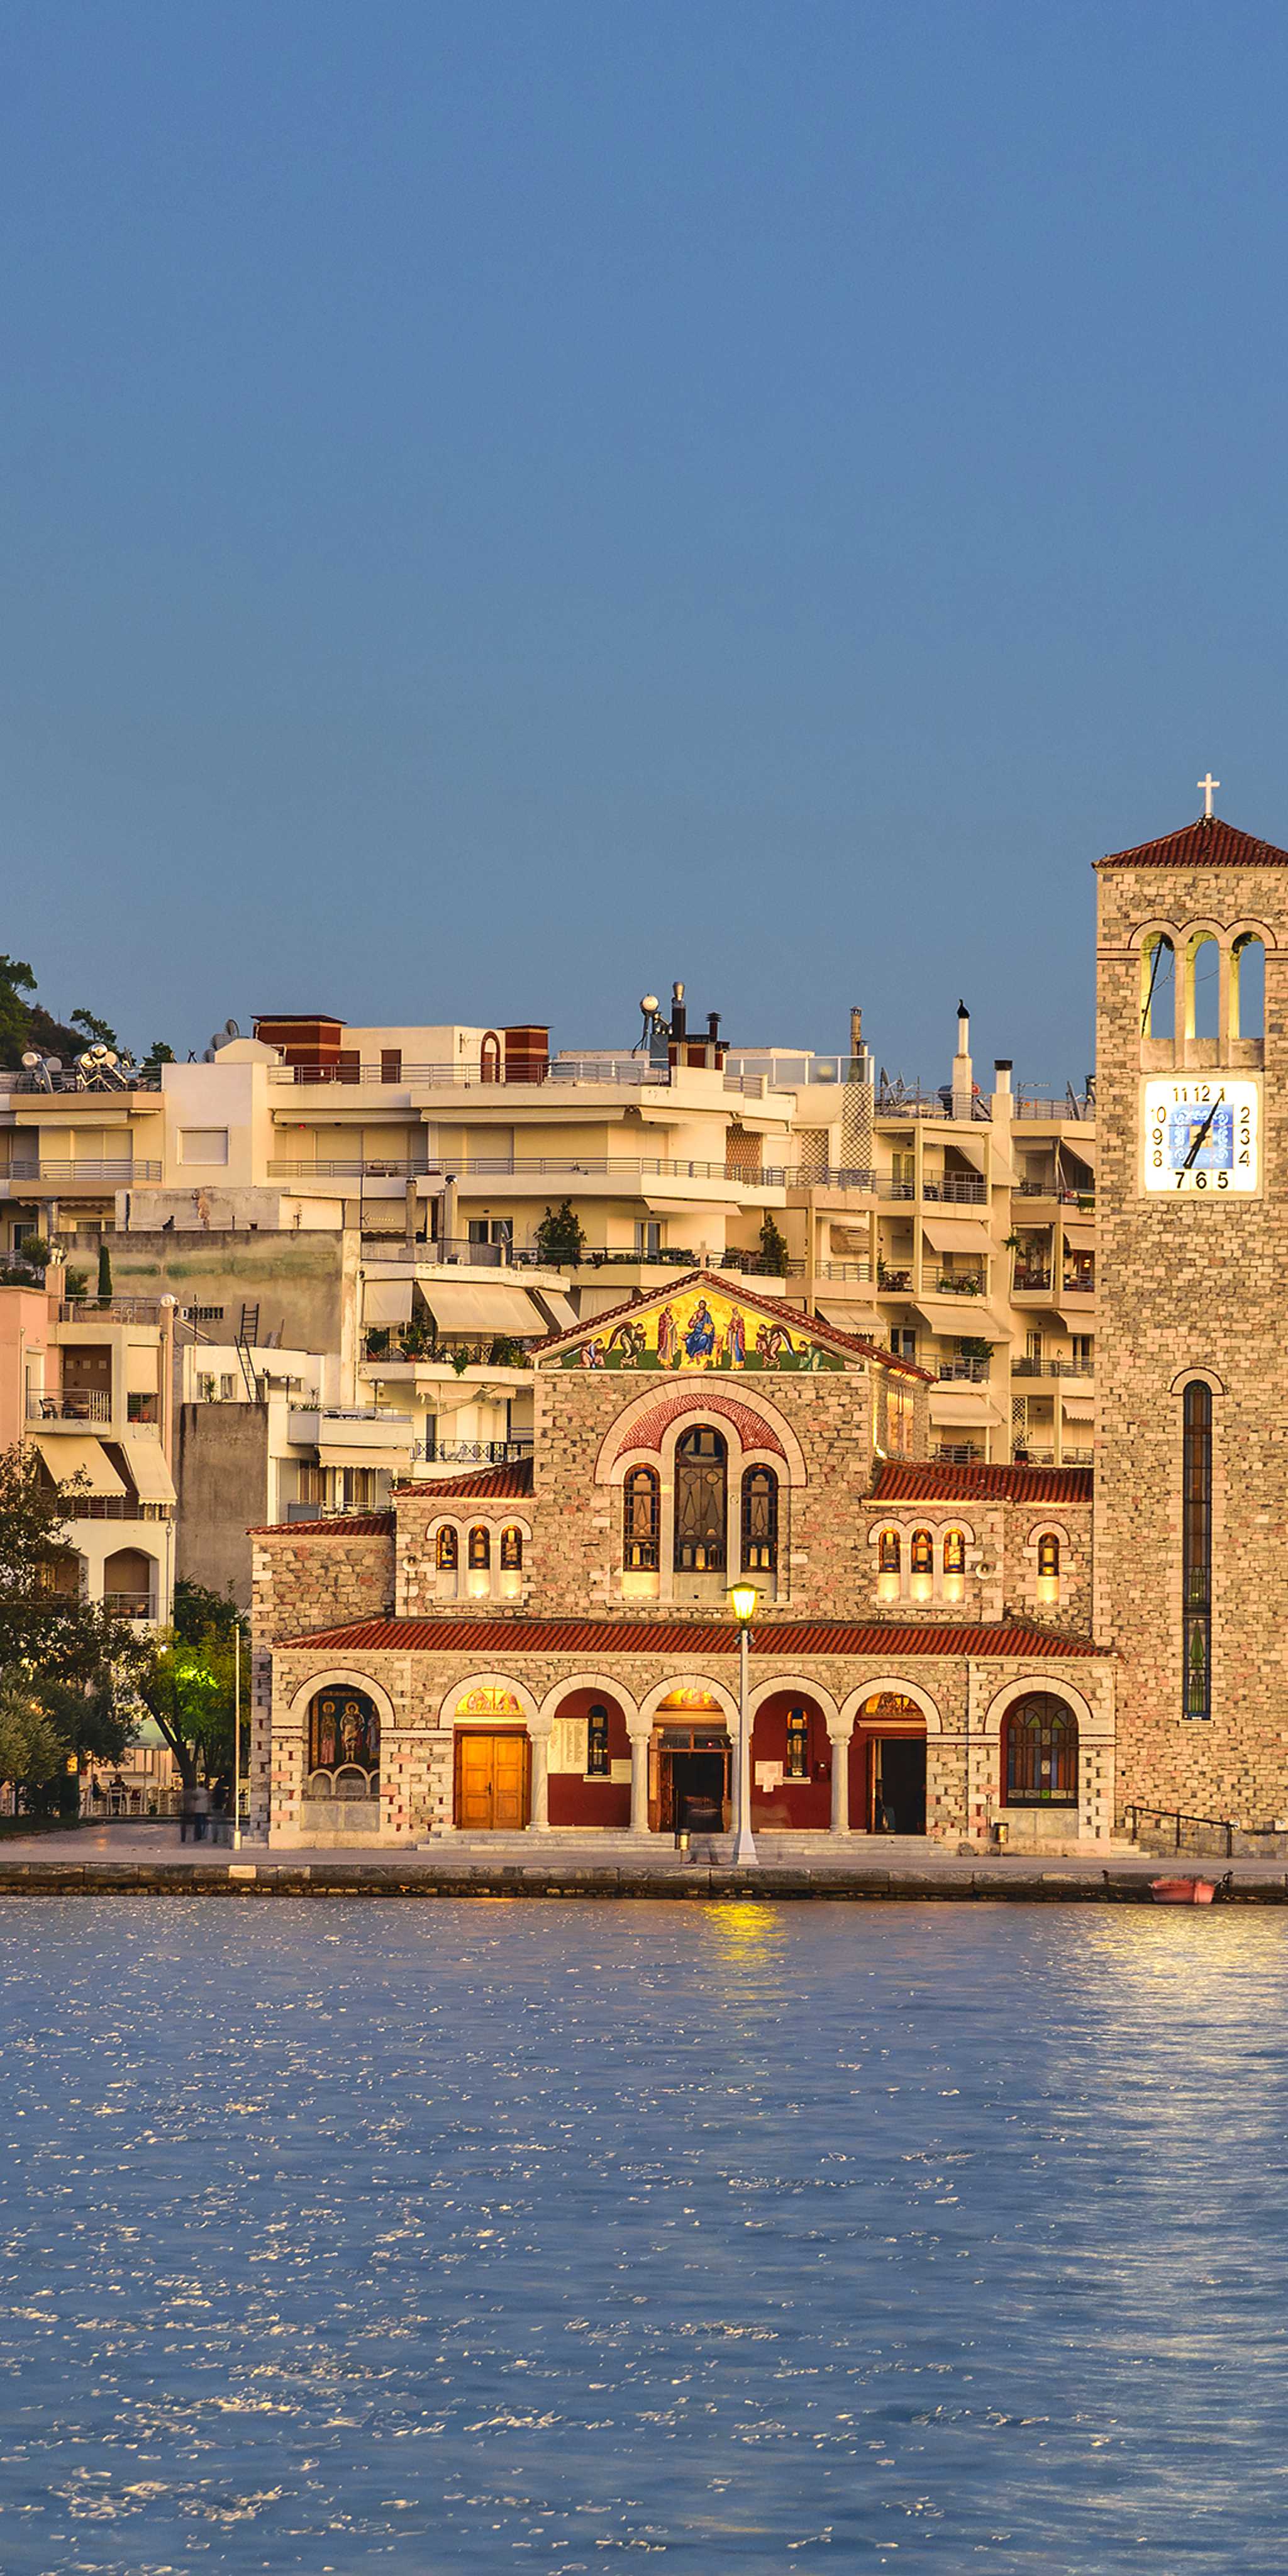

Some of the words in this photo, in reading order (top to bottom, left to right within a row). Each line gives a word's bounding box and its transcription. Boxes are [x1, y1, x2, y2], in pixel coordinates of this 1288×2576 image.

[1173, 1087, 1187, 1101] 11
[1194, 1085, 1210, 1101] 12
[1240, 1107, 1250, 1123] 2
[1152, 1128, 1162, 1145] 9
[1240, 1128, 1250, 1145] 3
[1153, 1150, 1162, 1167] 8
[1238, 1151, 1250, 1167] 4
[1175, 1172, 1185, 1188] 7
[1196, 1172, 1207, 1189] 6
[1218, 1172, 1228, 1189] 5
